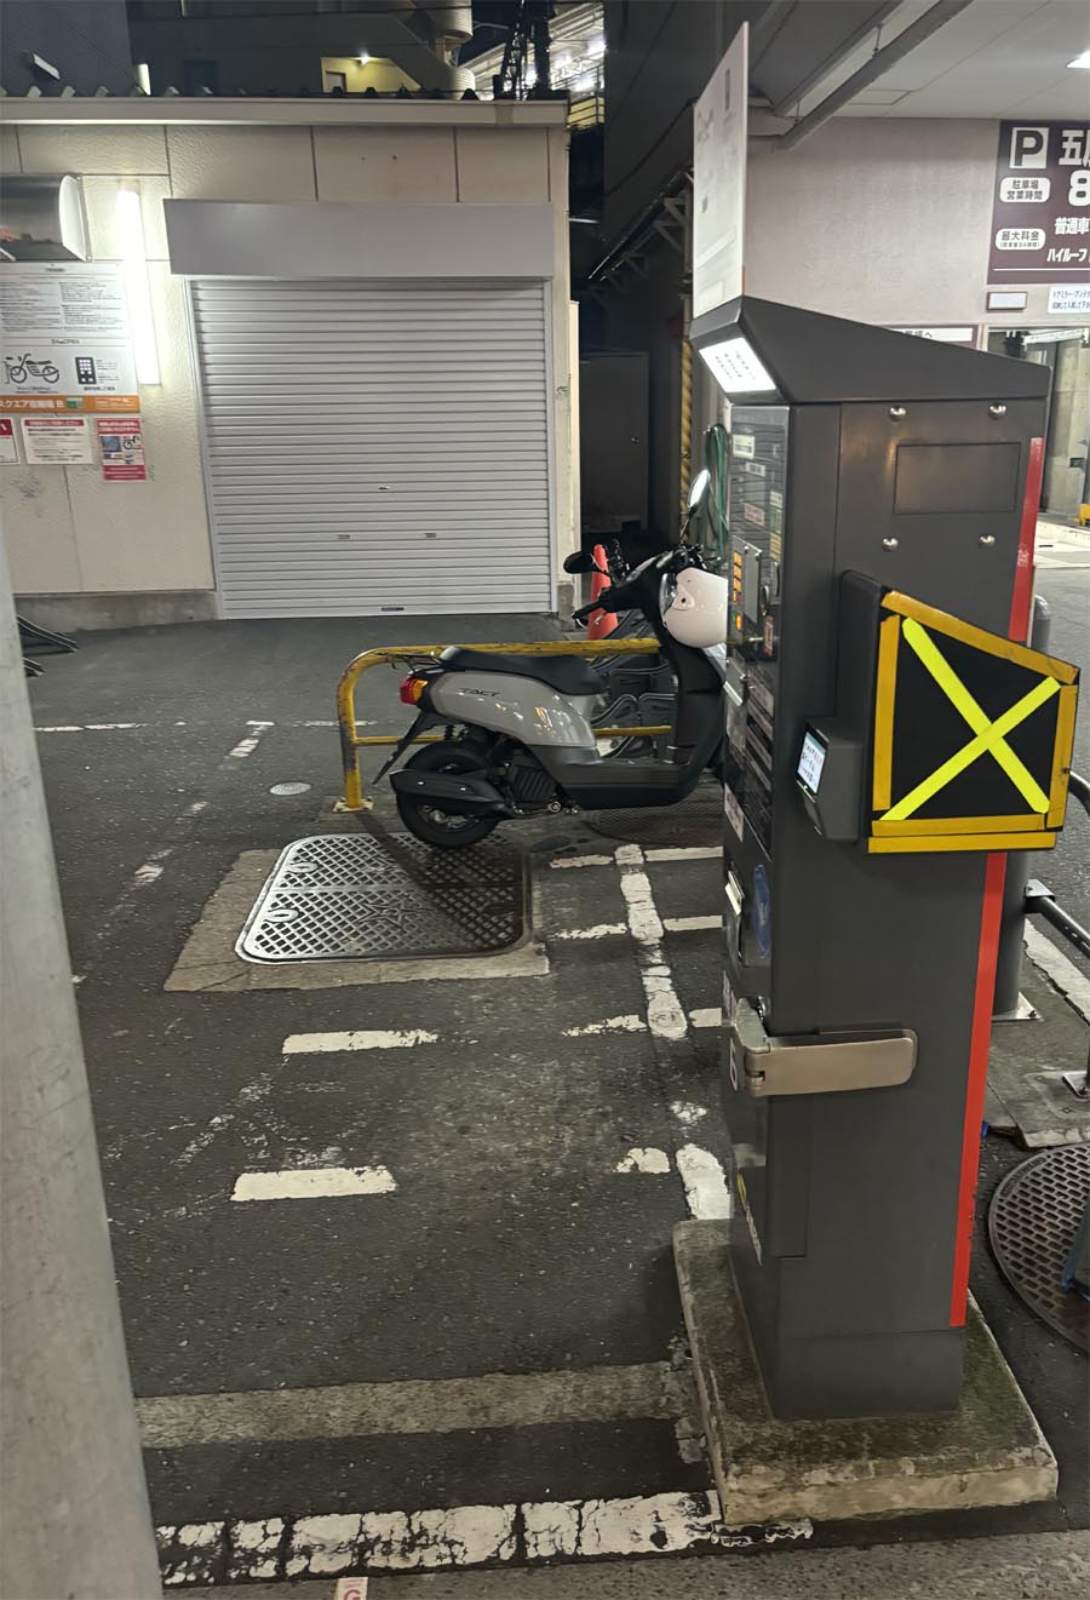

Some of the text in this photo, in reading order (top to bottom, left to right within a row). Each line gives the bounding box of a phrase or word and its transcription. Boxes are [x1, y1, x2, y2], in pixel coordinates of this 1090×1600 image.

[1014, 130, 1044, 167] P
[1012, 179, 1039, 190] 駐車場
[1006, 190, 1043, 200] 営業時間
[1001, 230, 1040, 241] 最大料金
[1046, 248, 1088, 263] ハイルーフ
